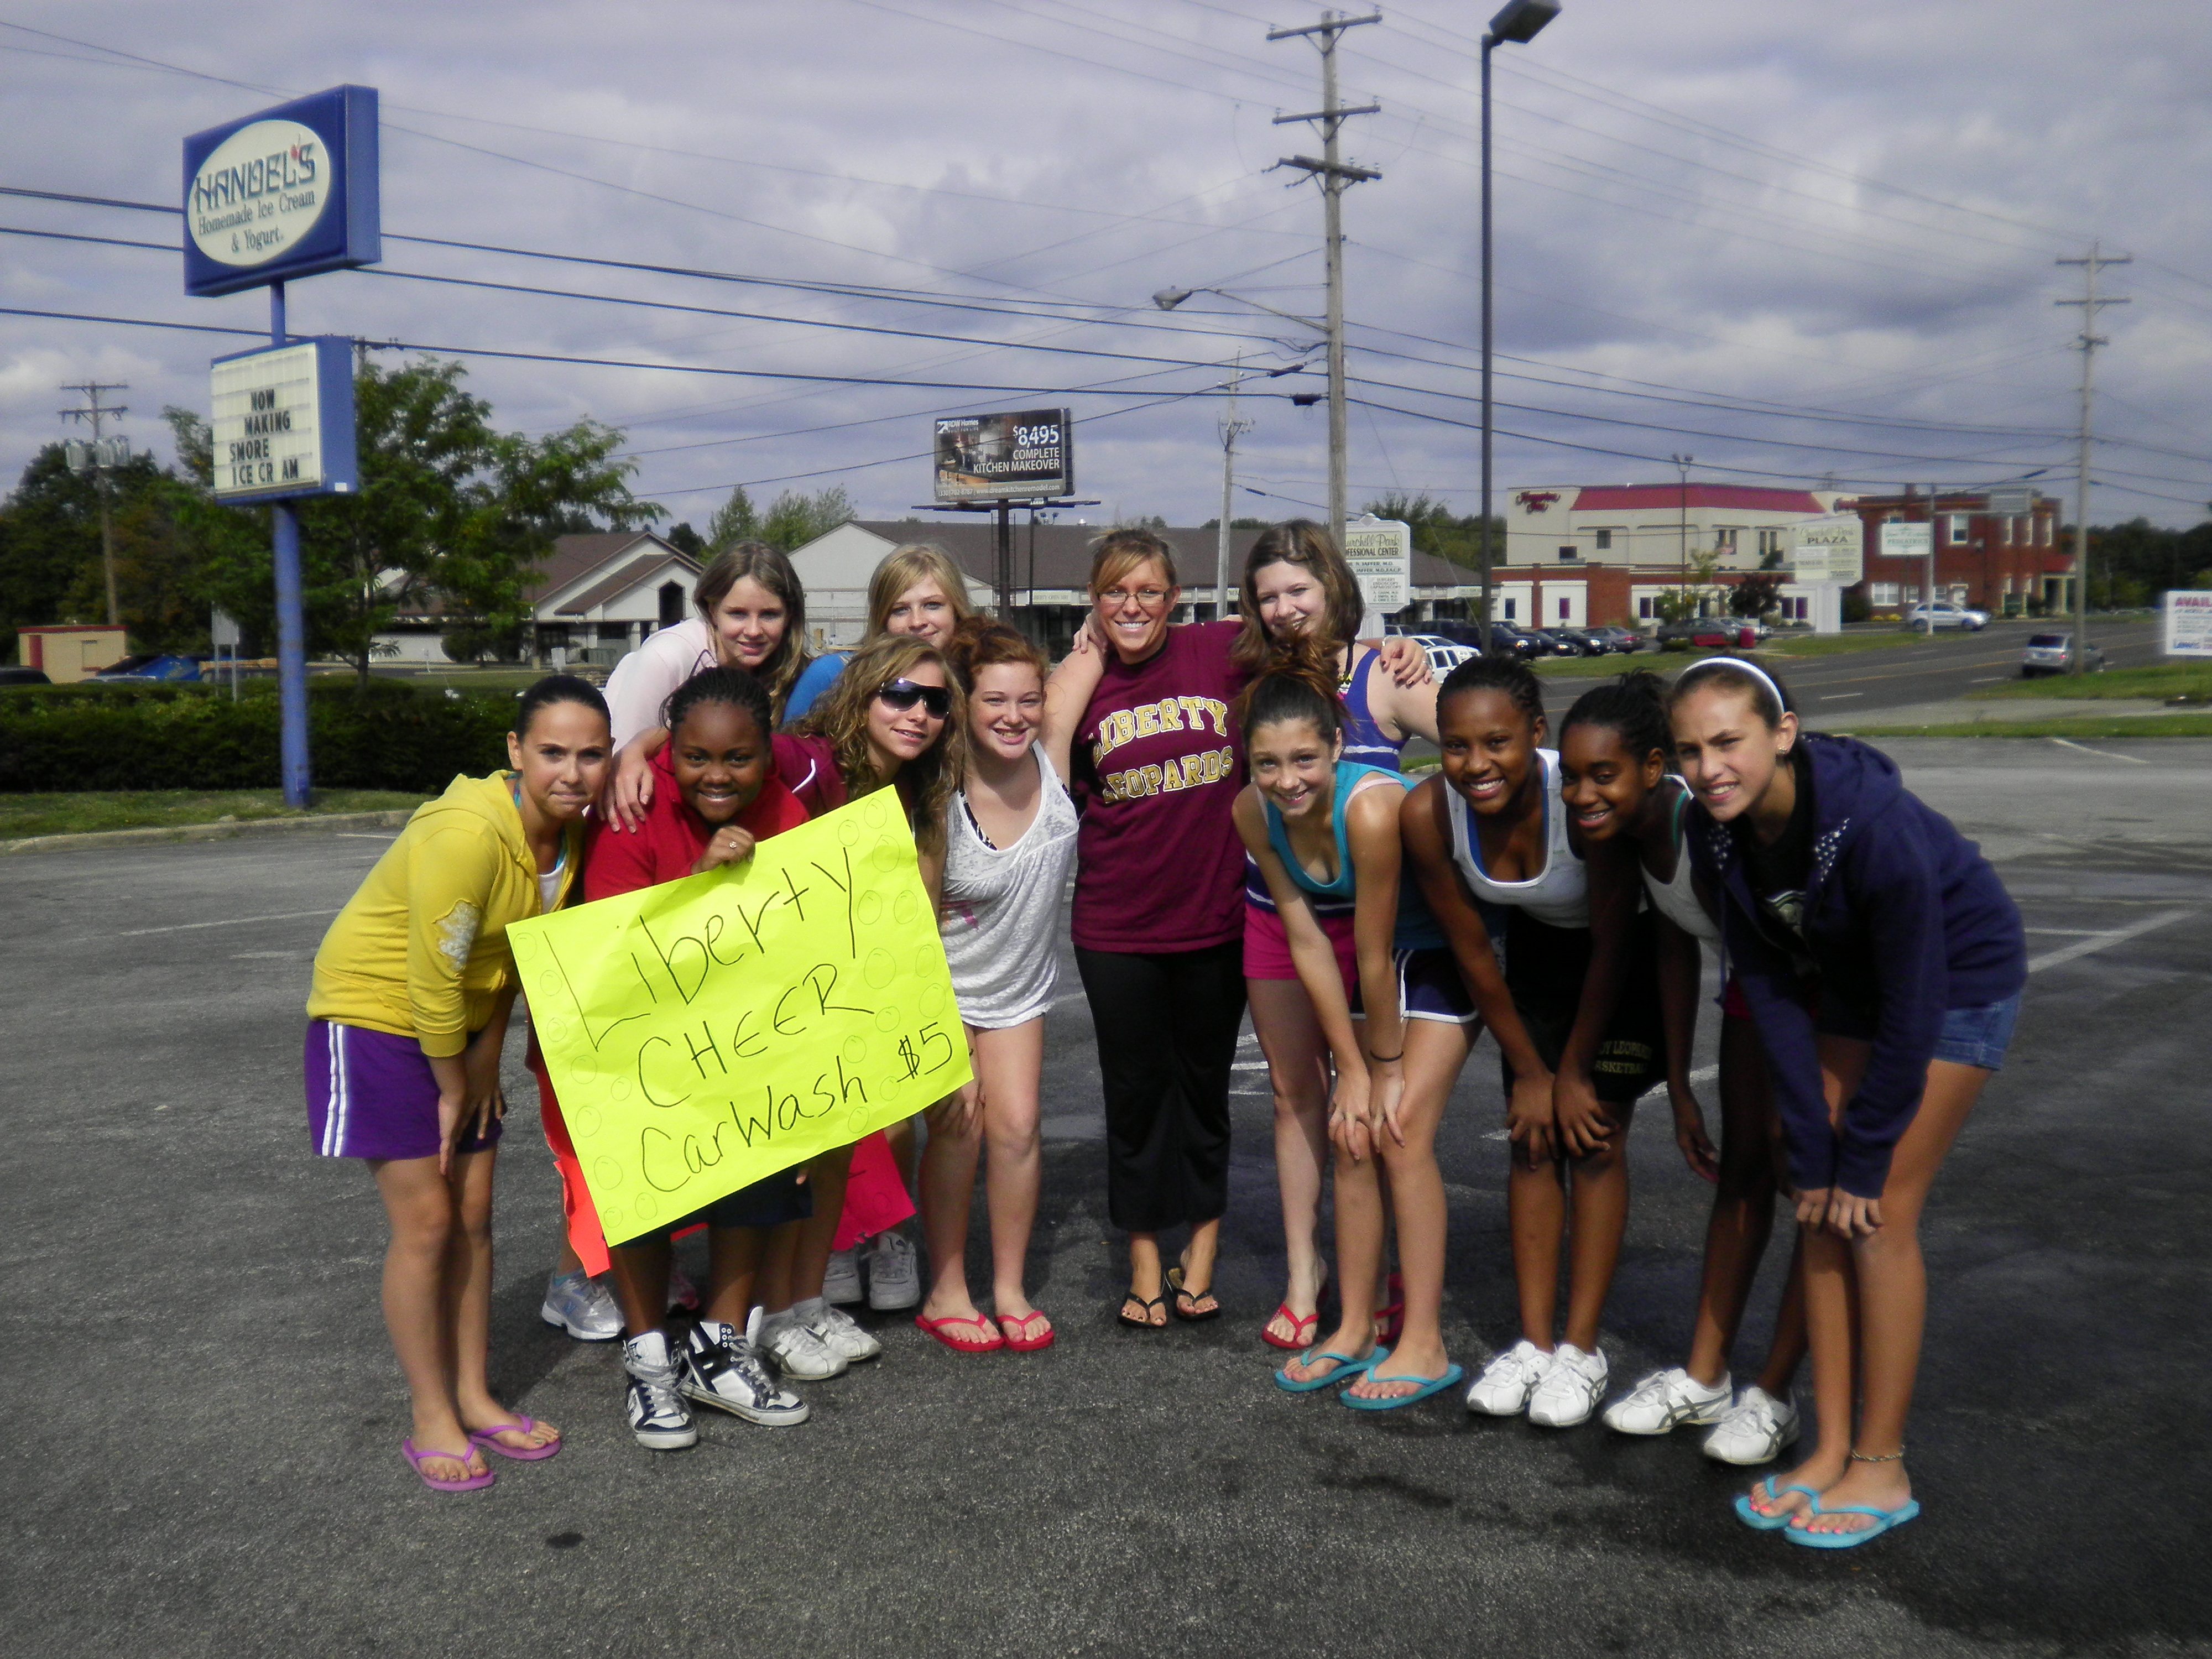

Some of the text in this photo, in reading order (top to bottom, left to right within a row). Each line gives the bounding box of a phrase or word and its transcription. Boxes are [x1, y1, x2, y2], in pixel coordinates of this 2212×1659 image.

[194, 142, 316, 214] HANDEL'S
[198, 190, 315, 236] Homemade Ice Cream
[231, 232, 240, 253] &
[251, 389, 275, 411] NOW
[244, 411, 291, 435] MAKING
[1013, 425, 1059, 448] $8,495
[229, 438, 269, 462] SMORE
[1013, 447, 1060, 460] COMPLETE
[232, 465, 253, 486] ICE
[973, 459, 1060, 474] KITCHEN MAKEOVER
[1346, 534, 1400, 547] urchill Park
[1807, 535, 1848, 544] PLAZA
[1345, 547, 1399, 556] FESSIONAL CENTER
[544, 846, 855, 1052] Liberty
[638, 963, 875, 1108] CHEER
[896, 1022, 953, 1084] $5
[1594, 1060, 1648, 1074] ASKETBAL
